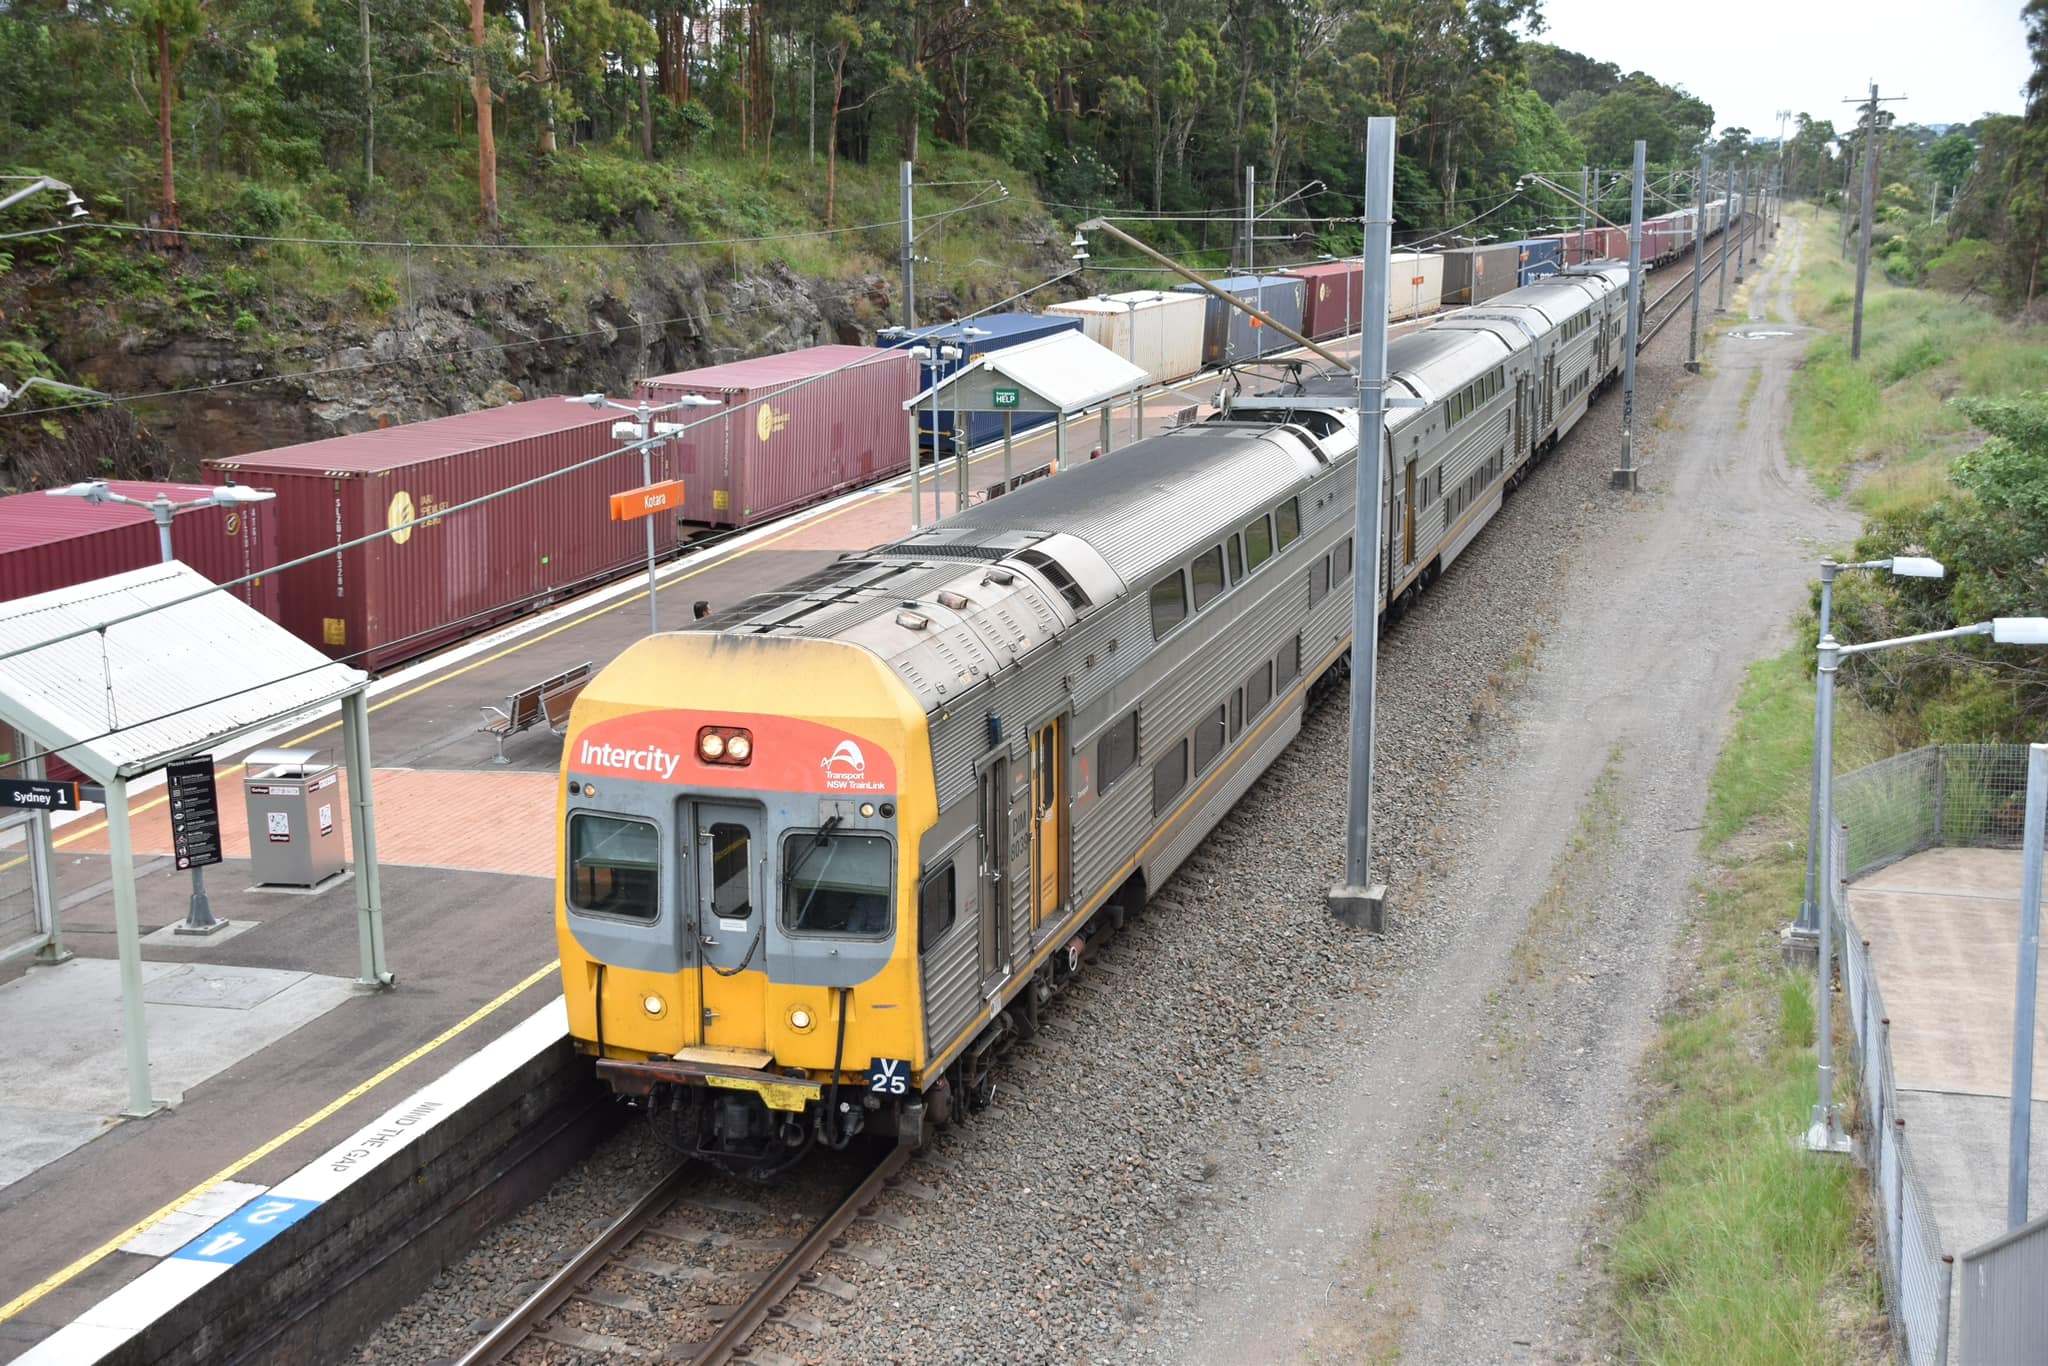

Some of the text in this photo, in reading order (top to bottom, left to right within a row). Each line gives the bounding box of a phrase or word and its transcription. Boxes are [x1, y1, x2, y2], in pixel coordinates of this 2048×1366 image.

[996, 395, 1015, 403] HELP
[644, 494, 667, 509] Kotara
[580, 739, 681, 780] Intercity
[826, 770, 865, 781] Transport
[826, 780, 885, 790] NSW TrainLink
[13, 788, 68, 805] Sydney 1
[880, 1058, 900, 1078] V
[871, 1073, 906, 1094] 25
[330, 1101, 443, 1172] MIND THE GAP
